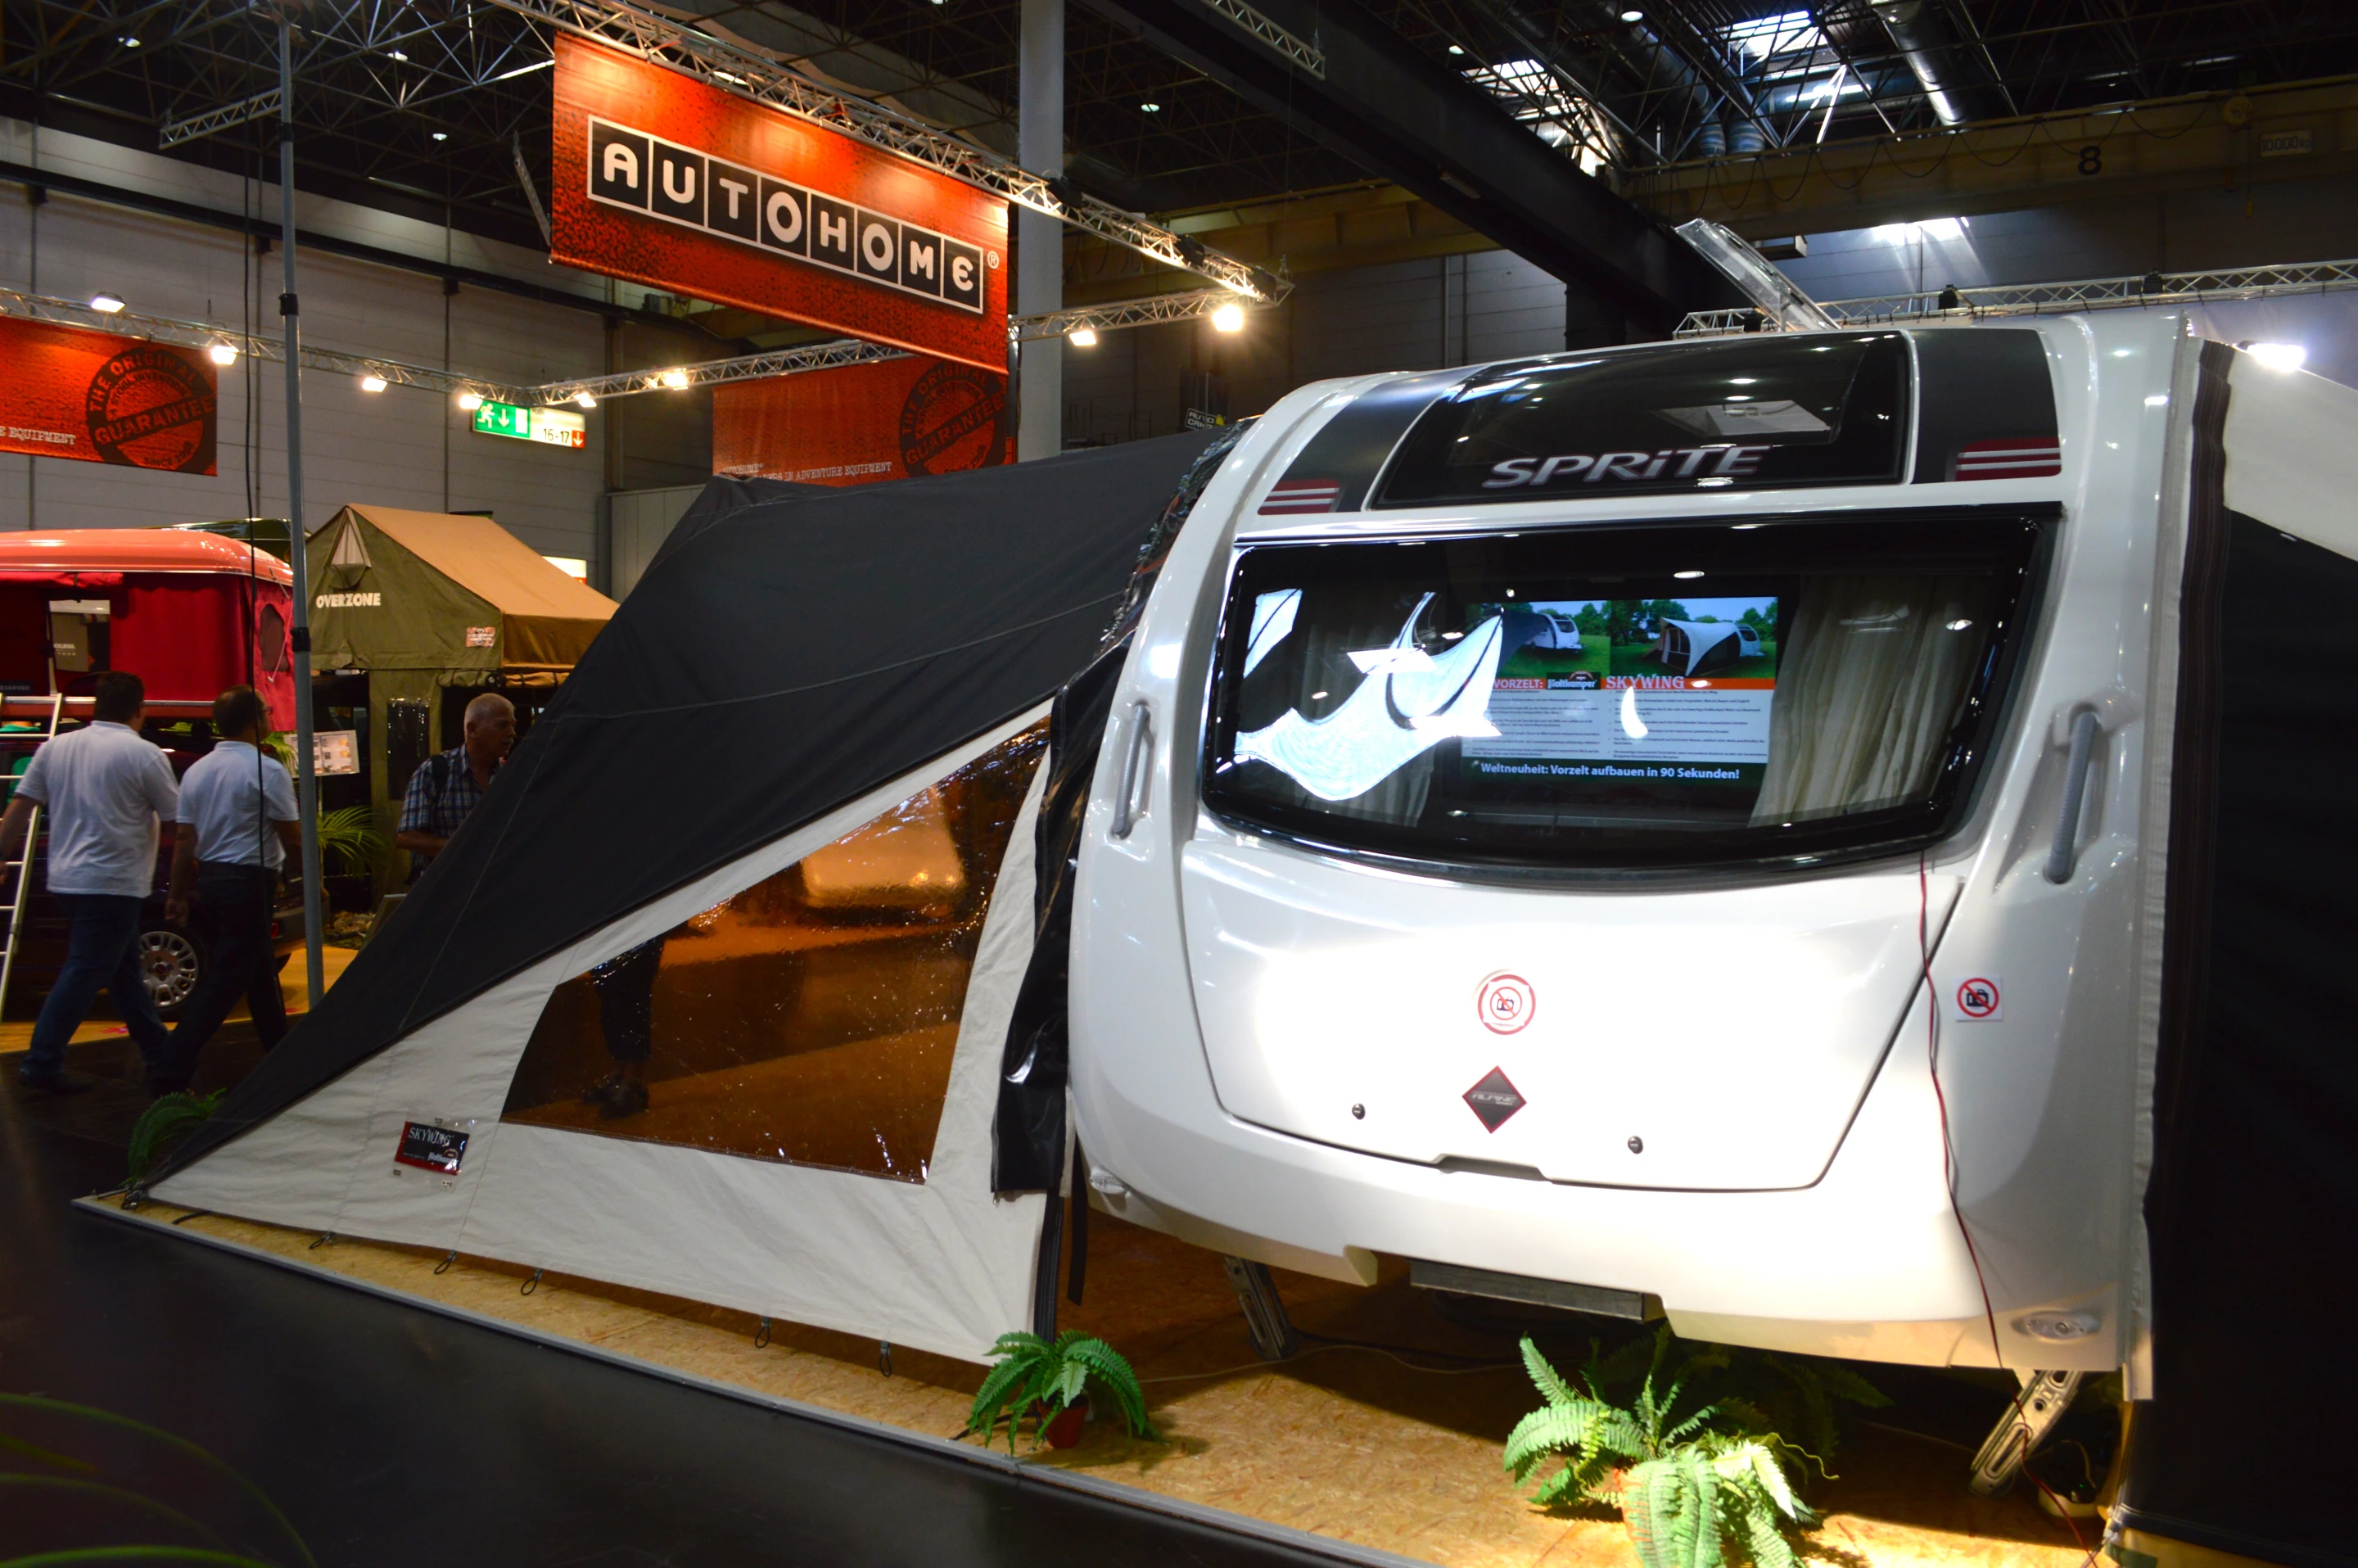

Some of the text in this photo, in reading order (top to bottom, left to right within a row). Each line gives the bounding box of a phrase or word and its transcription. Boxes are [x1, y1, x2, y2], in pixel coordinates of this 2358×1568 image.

[2078, 145, 2103, 176] 8
[90, 351, 196, 412] THE ORIGINAL
[94, 395, 216, 445] GUARANTEE
[901, 399, 918, 436] THE
[1189, 411, 1215, 423] AUTO
[8, 427, 76, 445] EQUIPMENT
[543, 427, 570, 444] 16-17
[906, 392, 1005, 465] GUARANTEE
[784, 472, 794, 481] IN
[796, 466, 842, 481] ADVENTURE
[845, 462, 892, 477] EQUIPMENT
[315, 592, 382, 608] OVERZONE
[1606, 673, 1685, 689] SKYWING
[1480, 762, 1740, 779] Weltneuheit: Vorzelt aufbauen in 90 Sekunden!
